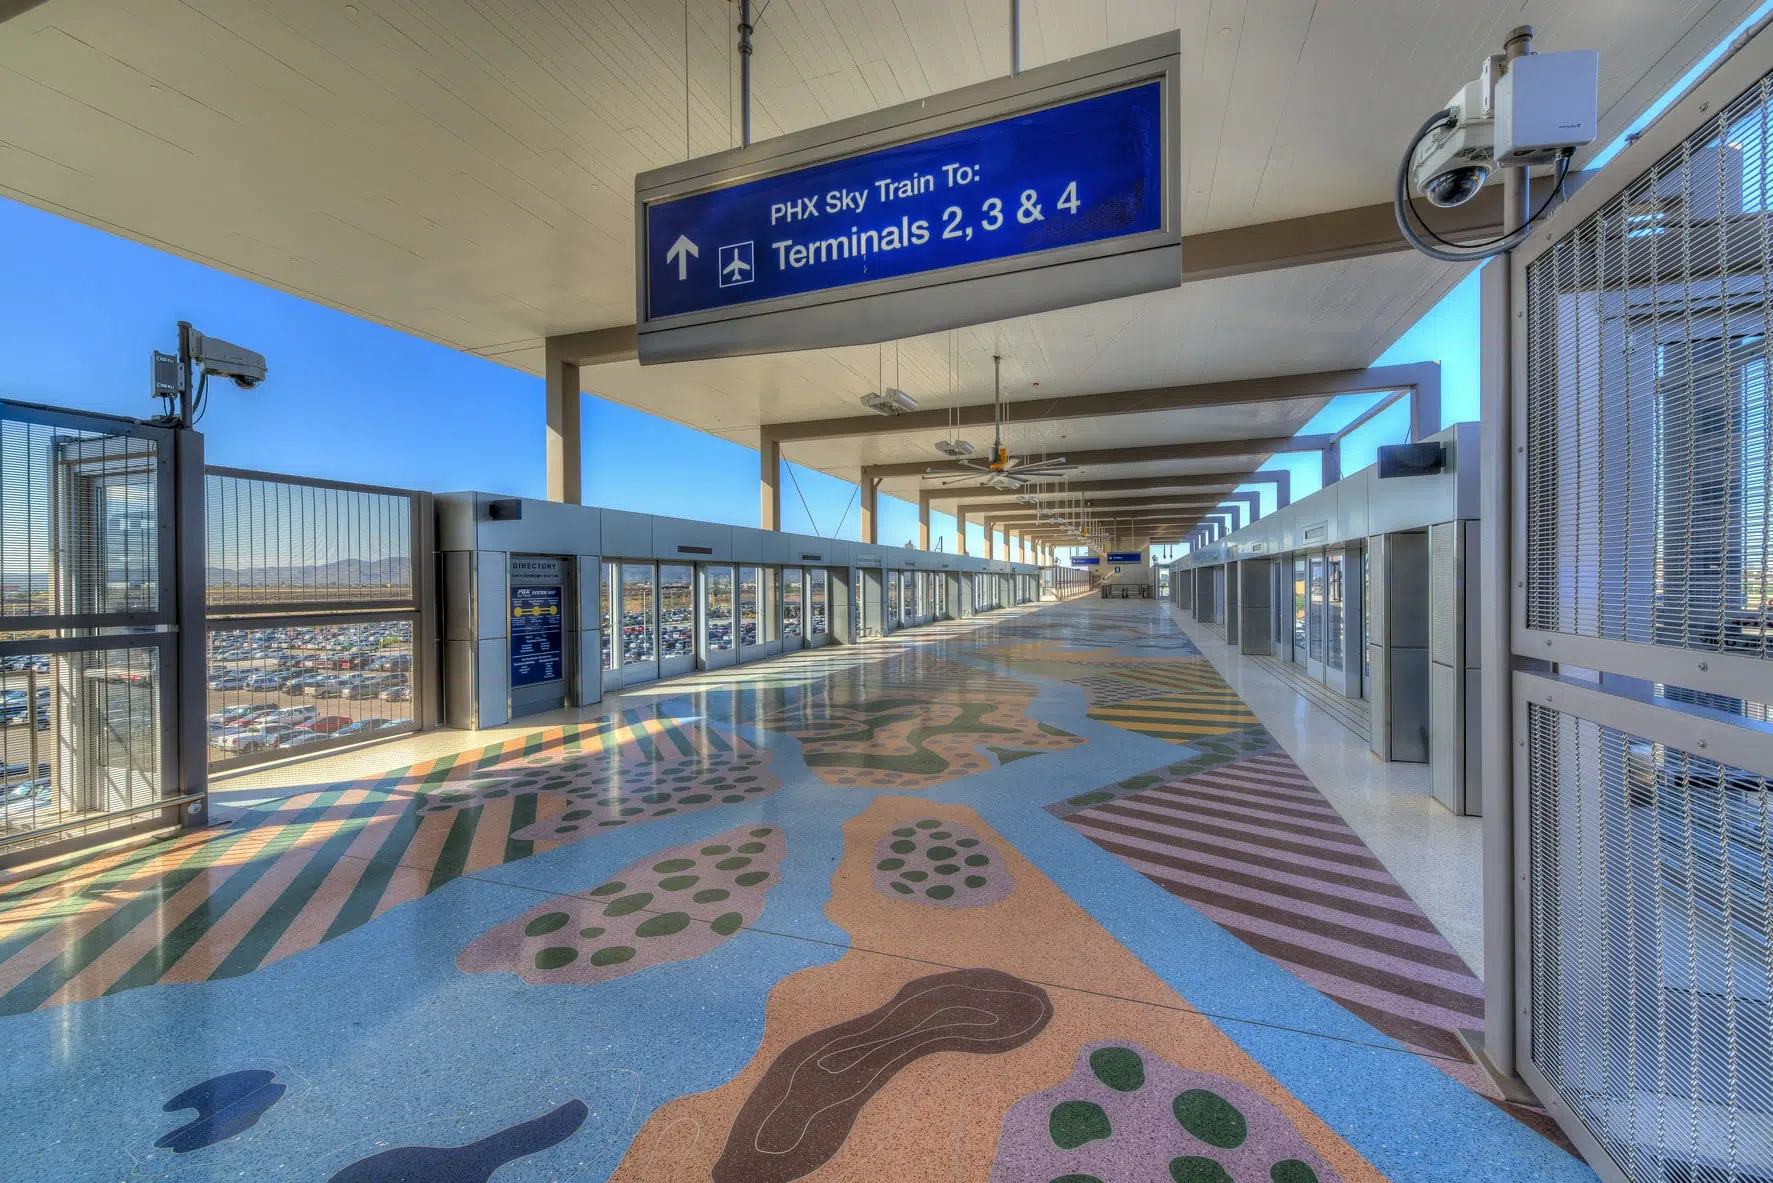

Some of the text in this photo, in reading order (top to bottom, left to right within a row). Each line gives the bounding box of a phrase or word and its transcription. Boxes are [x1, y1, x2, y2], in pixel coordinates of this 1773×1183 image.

[771, 163, 980, 226] PHX Sky Train To:
[772, 181, 1081, 270] Terminals 2, 3 & 4
[512, 562, 557, 570] DIRECTORY
